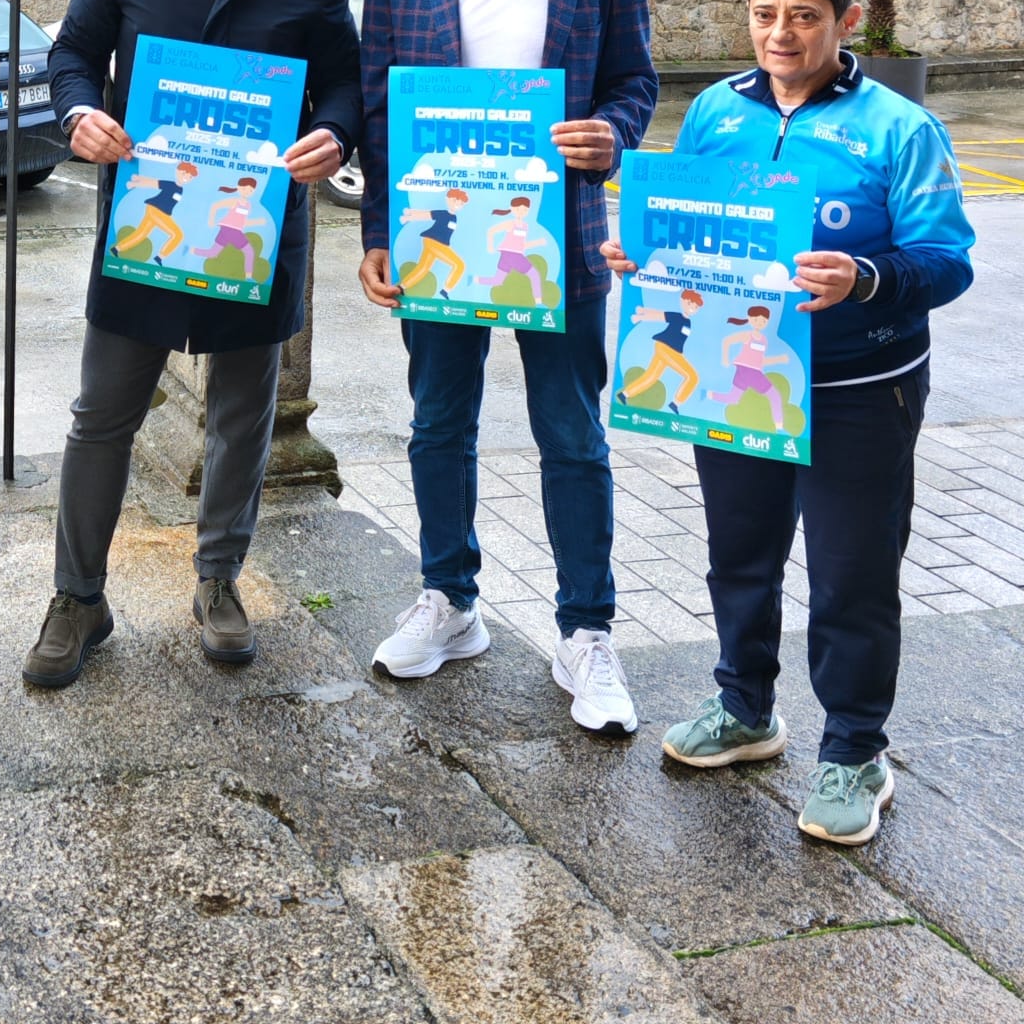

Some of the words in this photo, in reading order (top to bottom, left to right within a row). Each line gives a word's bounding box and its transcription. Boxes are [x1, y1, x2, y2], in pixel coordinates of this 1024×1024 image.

[157, 78, 226, 100] CAMPIONATO
[227, 89, 271, 107] GALEGO
[149, 90, 274, 142] CROSS
[167, 139, 201, 153] 17/1/26
[210, 147, 231, 158] 11:00
[413, 119, 535, 157] CROSS
[813, 127, 857, 150] Ribadeo
[136, 144, 191, 161] CAMPAMENTO
[192, 154, 226, 167] XUVENIL
[228, 160, 235, 169] A
[236, 161, 268, 175] DEVESA
[404, 177, 458, 188] CAMPAMENTO
[461, 180, 495, 190] XUVENIL
[498, 182, 504, 190] A
[506, 182, 539, 192] DEVESA
[433, 168, 467, 178] 17/1/26
[478, 171, 497, 179] 11:00
[647, 195, 723, 216] CAMPIONATO
[725, 203, 774, 221] GALEGO
[642, 209, 778, 262] CROSS
[666, 265, 701, 278] 17/1/26
[712, 272, 734, 283] 11:00
[682, 253, 731, 271] 2025-26
[638, 272, 692, 289] CAMPAMENTO
[695, 280, 730, 295] XUVENIL
[734, 286, 740, 296] A
[743, 288, 781, 302] DEVESA
